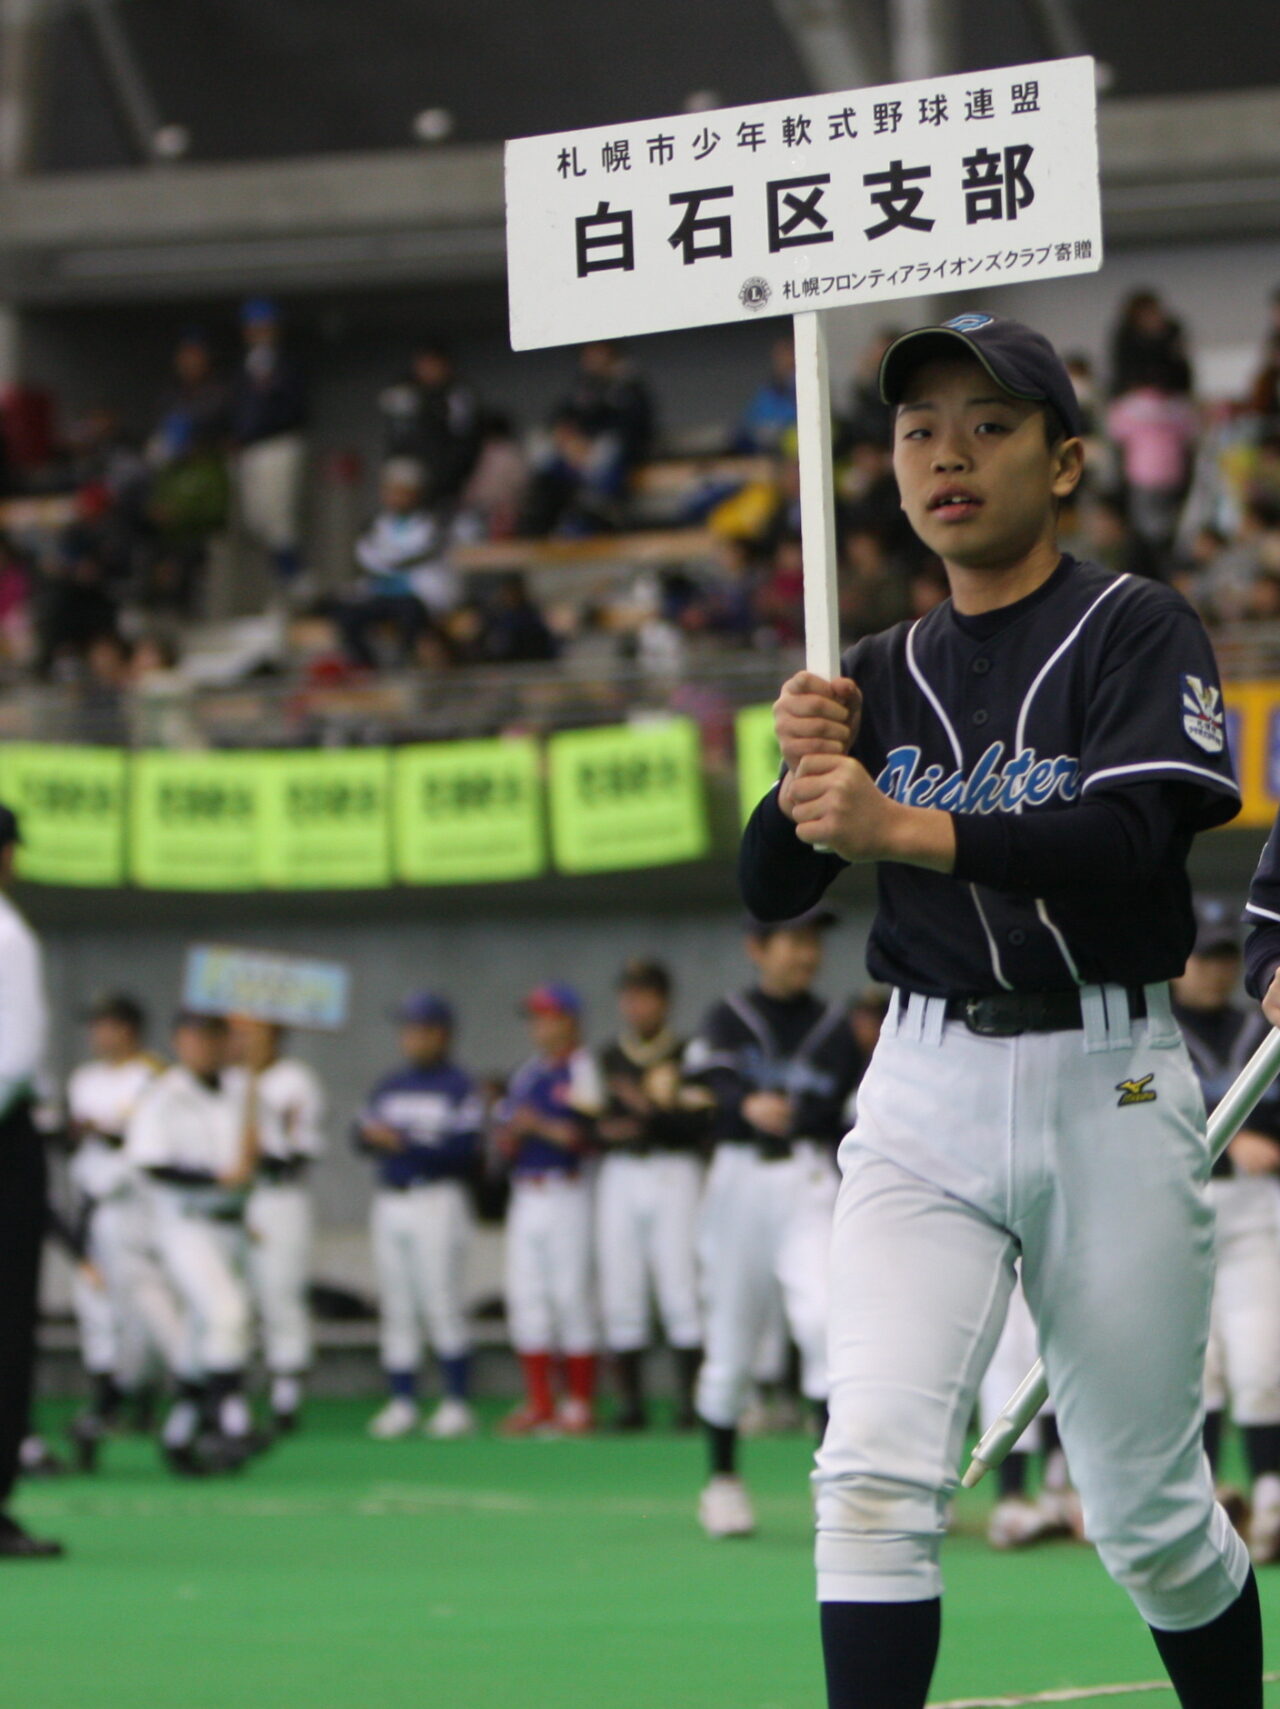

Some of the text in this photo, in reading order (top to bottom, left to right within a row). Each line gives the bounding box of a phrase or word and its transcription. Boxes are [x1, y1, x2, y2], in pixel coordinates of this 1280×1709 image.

[556, 80, 1041, 180] 札幌市少年軟式野球連盟
[574, 142, 1036, 278] 白石区支部
[782, 239, 1093, 300] 札幌フロンティアライオンズクラブ寄贈
